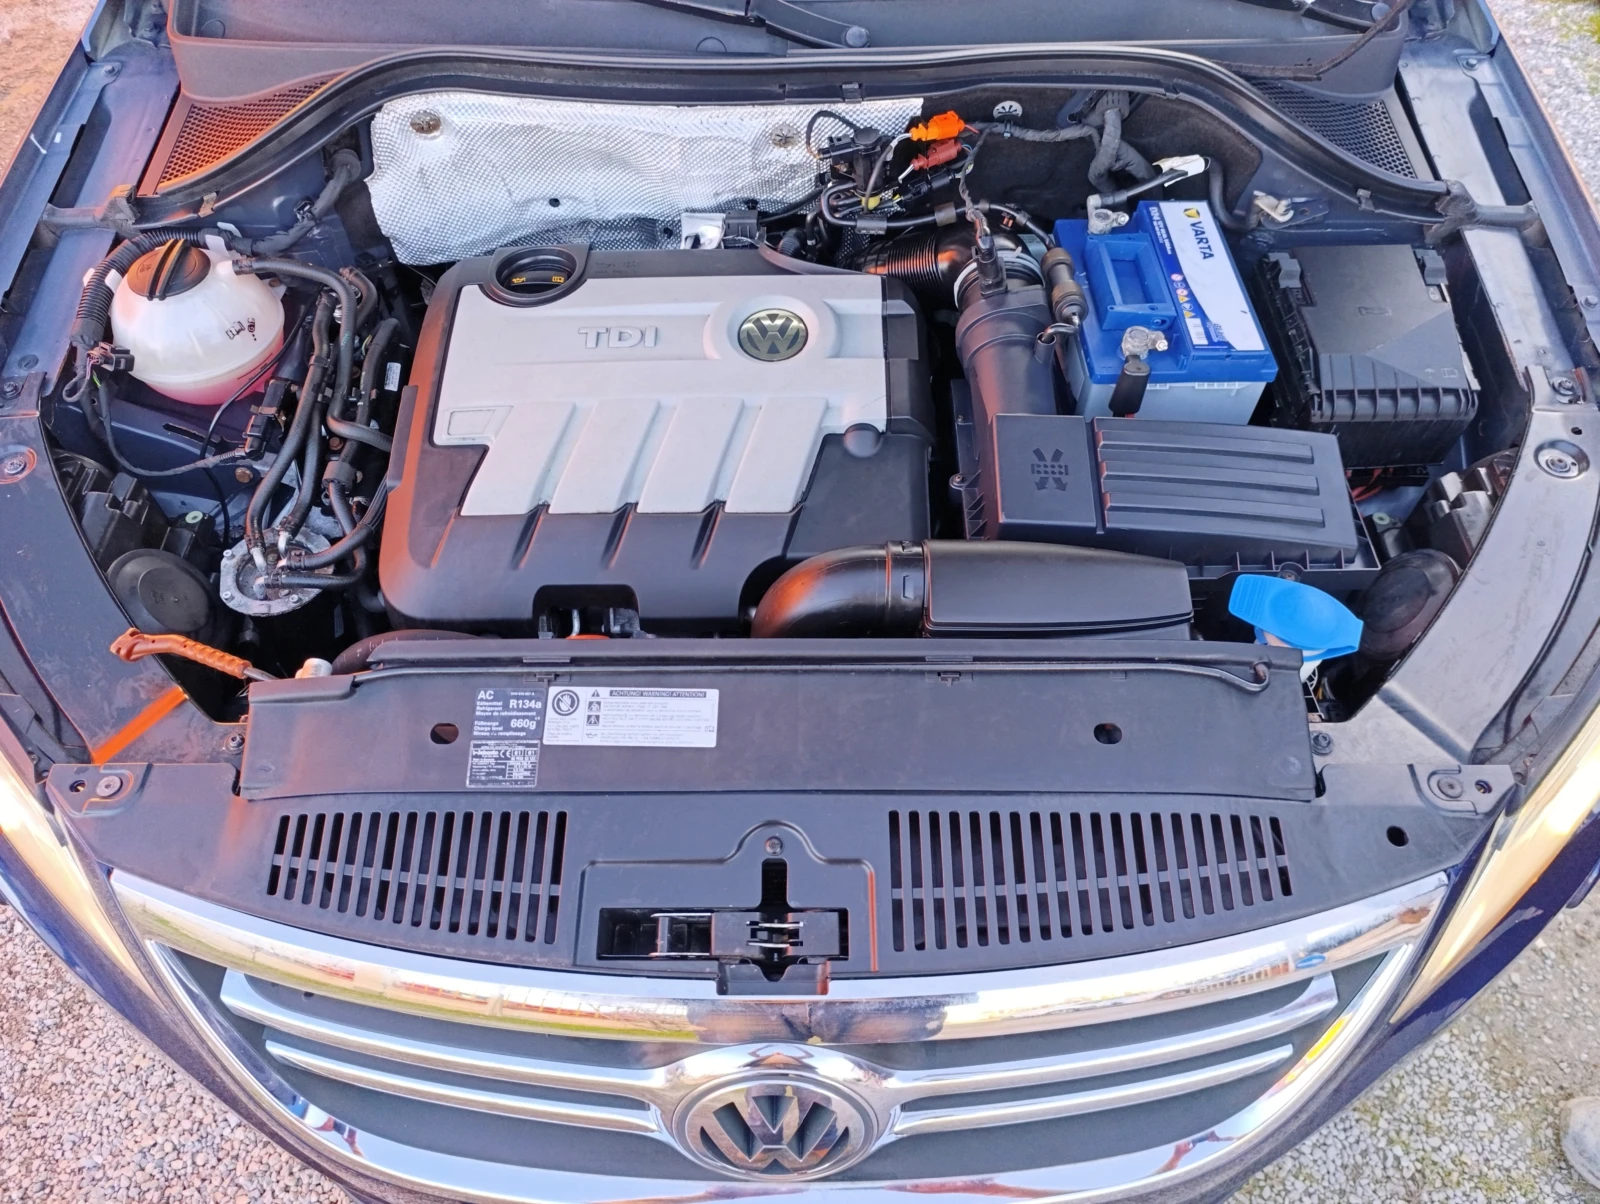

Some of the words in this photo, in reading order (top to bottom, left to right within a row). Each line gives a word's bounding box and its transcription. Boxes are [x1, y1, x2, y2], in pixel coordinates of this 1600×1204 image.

[1190, 221, 1214, 260] VARTA
[578, 326, 658, 350] TDI
[477, 690, 495, 700] AC
[509, 699, 542, 709] R134a
[510, 718, 537, 730] 660g
